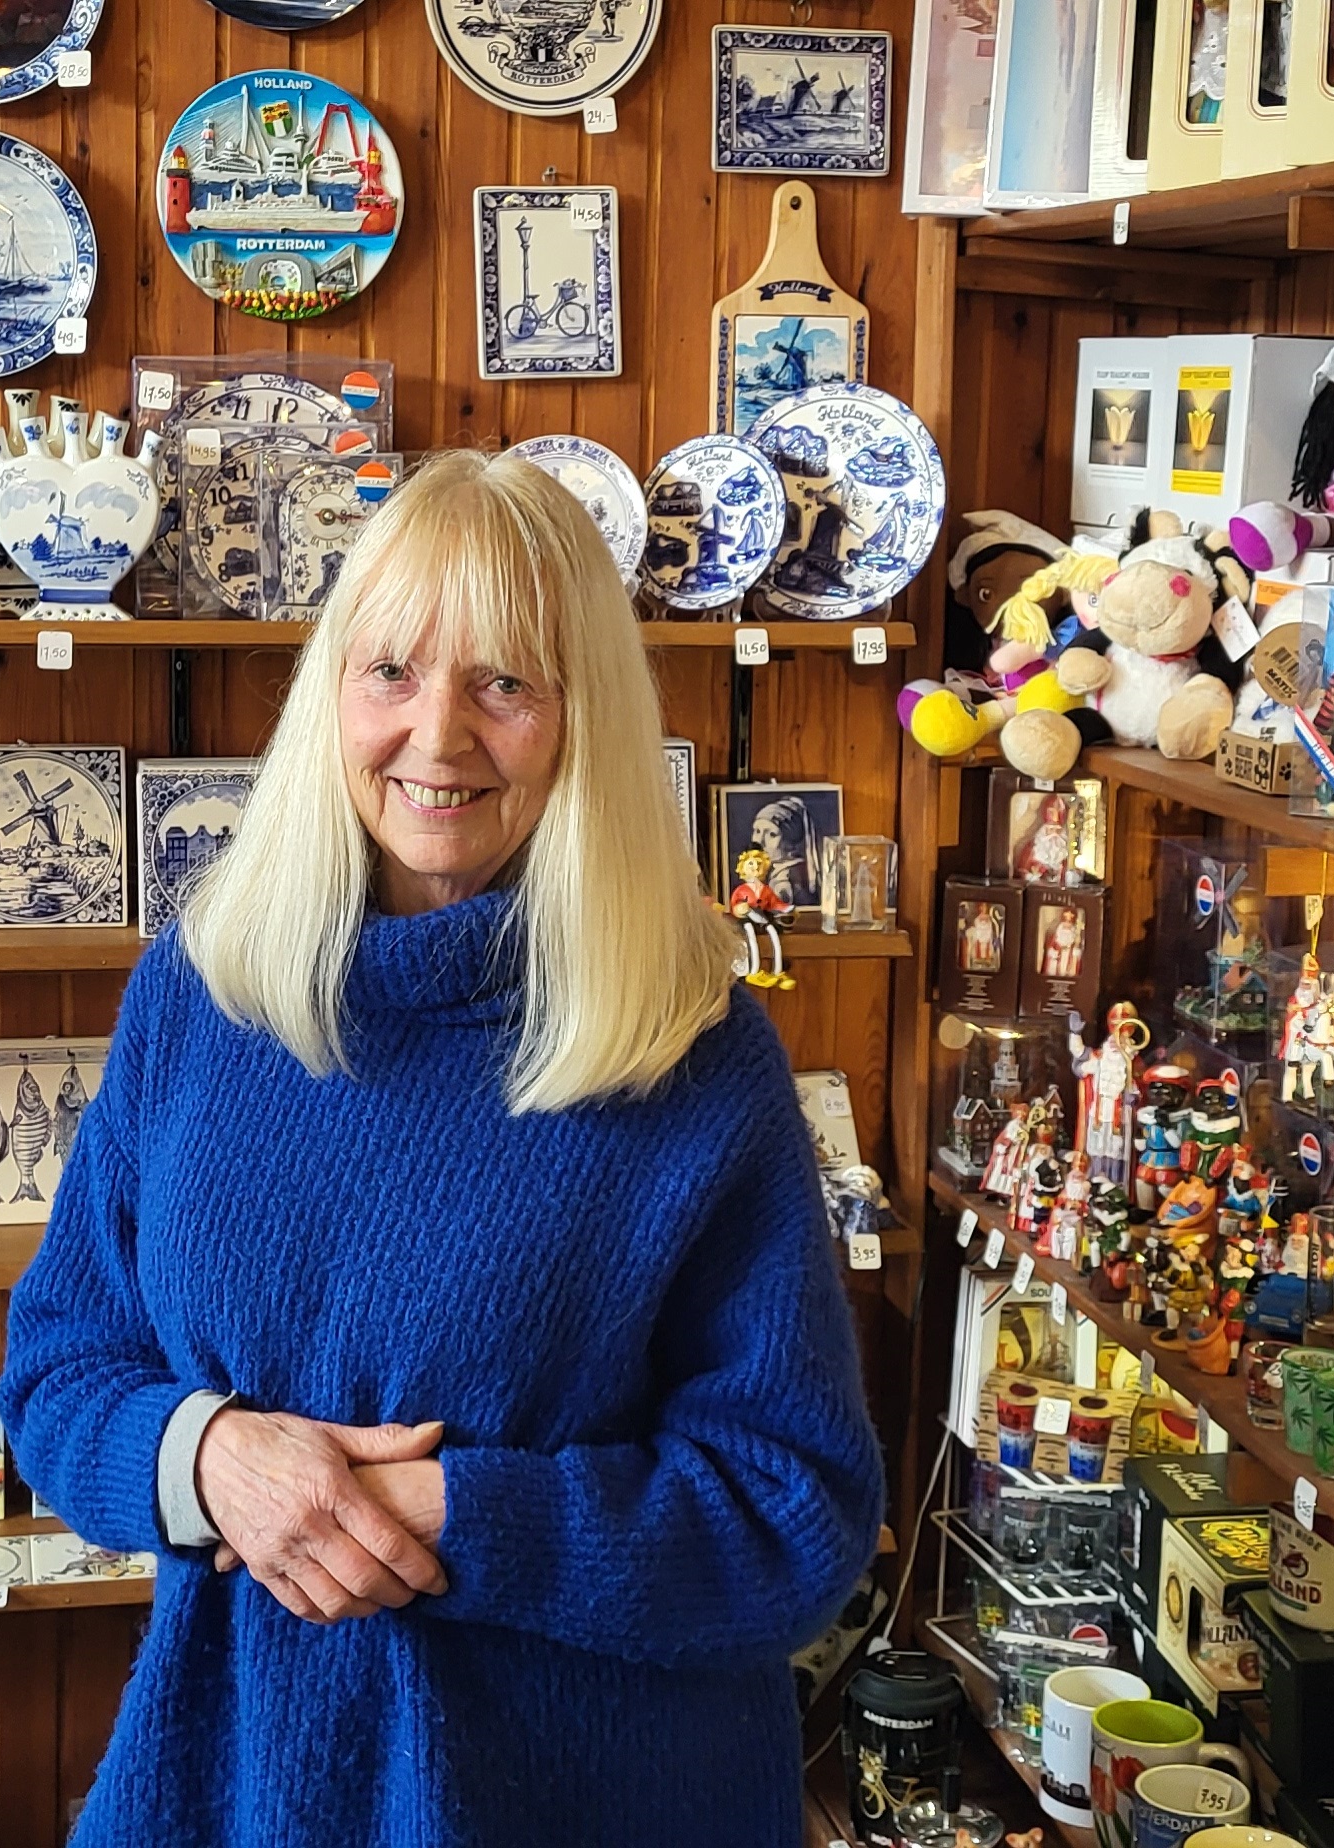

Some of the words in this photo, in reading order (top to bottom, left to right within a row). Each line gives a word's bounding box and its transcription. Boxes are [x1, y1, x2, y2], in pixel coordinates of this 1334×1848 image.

[253, 77, 313, 91] HOLLAND
[509, 71, 577, 85] ROTTERDAM
[236, 238, 326, 251] ROTTERDAM
[768, 281, 823, 295] Holland
[817, 404, 886, 430] Holland
[685, 448, 733, 471] Holland
[1030, 1287, 1051, 1298] SOU
[863, 1709, 934, 1730] AMSTERDAM
